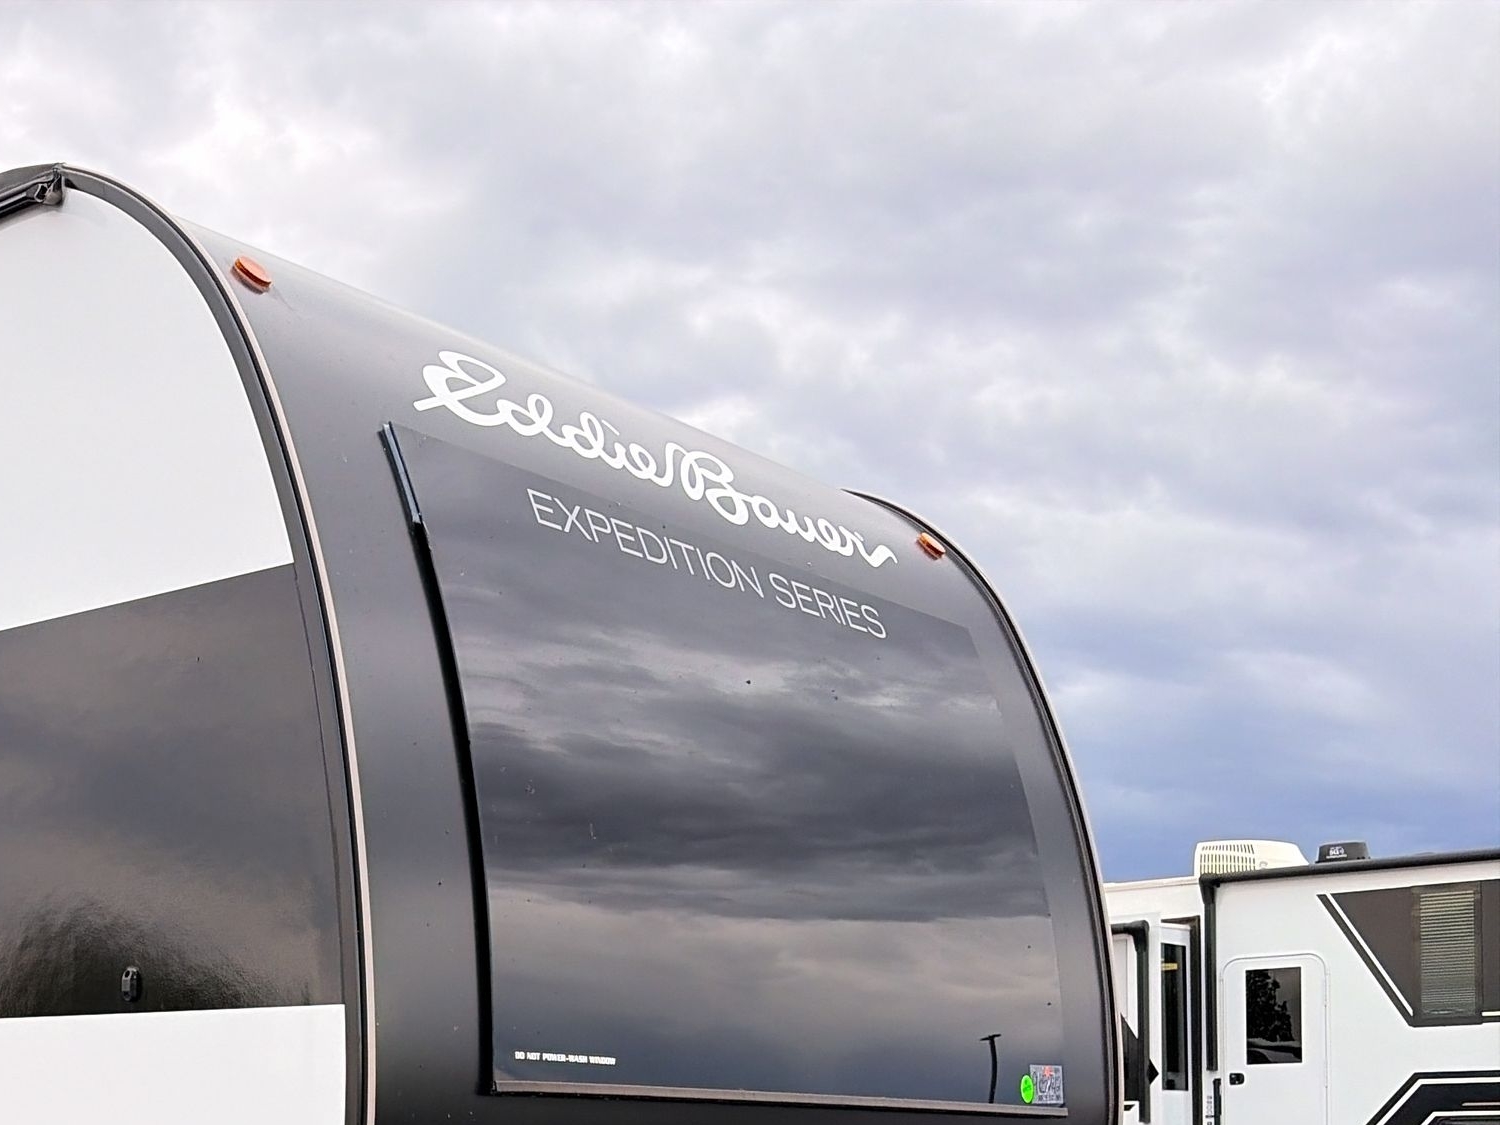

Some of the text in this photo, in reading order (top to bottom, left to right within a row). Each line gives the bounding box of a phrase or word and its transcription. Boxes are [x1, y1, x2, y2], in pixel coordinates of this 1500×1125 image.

[413, 350, 898, 568] Eddie Bauer
[526, 488, 887, 640] EXPEDITION SERIES
[526, 1052, 540, 1061] NOT
[588, 1056, 616, 1065] WINDOW
